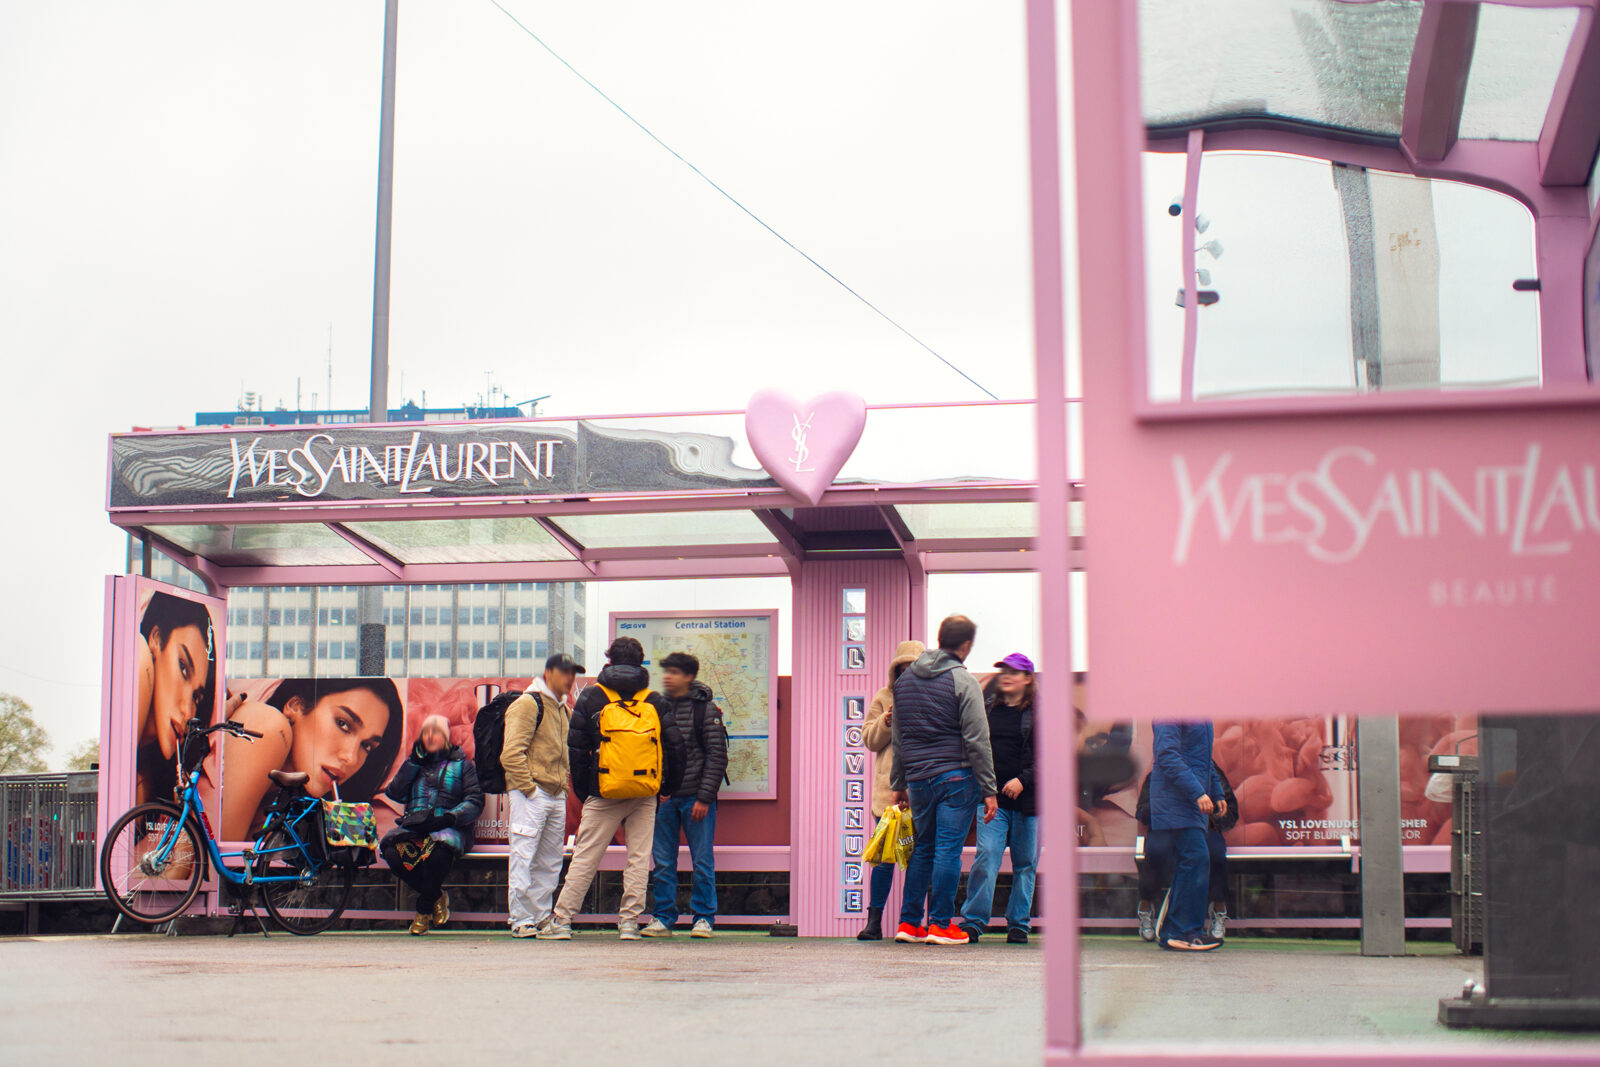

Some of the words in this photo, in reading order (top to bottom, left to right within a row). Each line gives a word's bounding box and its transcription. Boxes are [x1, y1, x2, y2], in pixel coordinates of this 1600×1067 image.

[675, 620, 713, 630] Centraal
[714, 619, 746, 629] Station
[1278, 820, 1298, 829] YSL
[1300, 819, 1359, 829] LOVENUDE
[1286, 830, 1311, 840] SOFT
